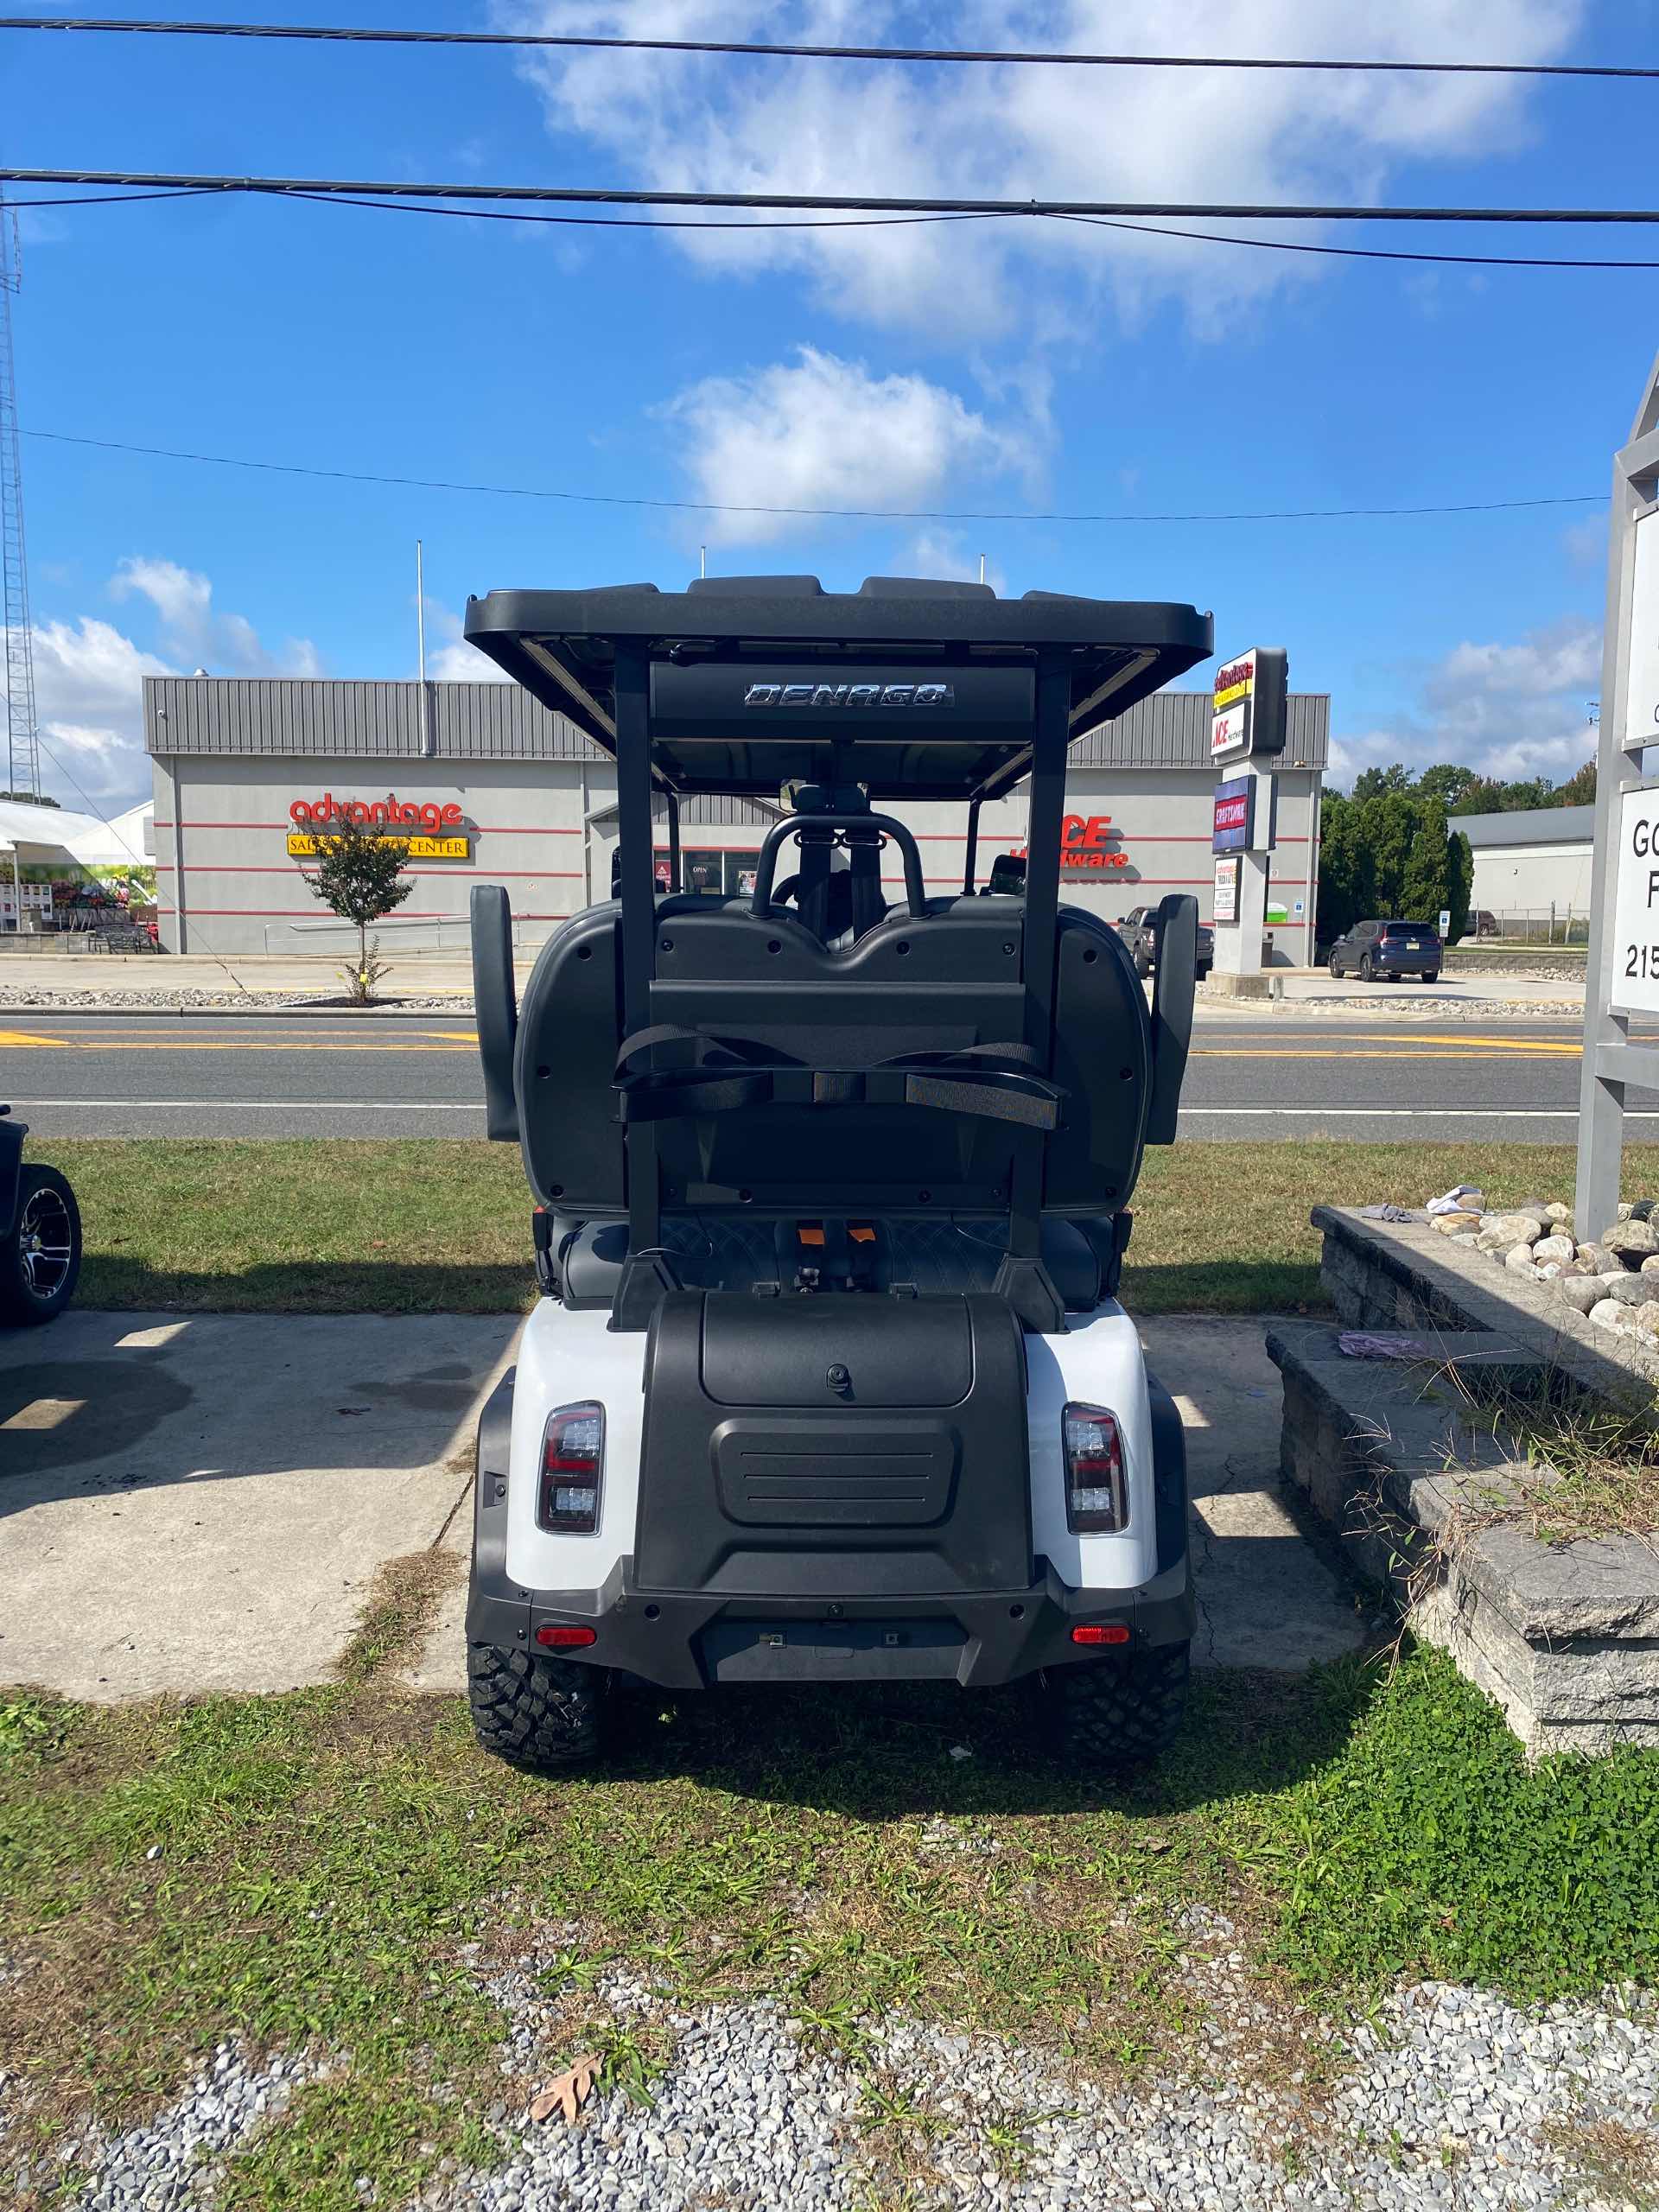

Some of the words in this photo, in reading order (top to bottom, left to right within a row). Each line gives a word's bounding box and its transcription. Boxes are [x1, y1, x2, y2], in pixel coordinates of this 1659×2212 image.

[744, 683, 948, 705] DENAGO
[1212, 719, 1229, 747] ACE
[289, 792, 463, 833] advantage
[1061, 814, 1112, 849] CE
[407, 841, 463, 853] CENTER
